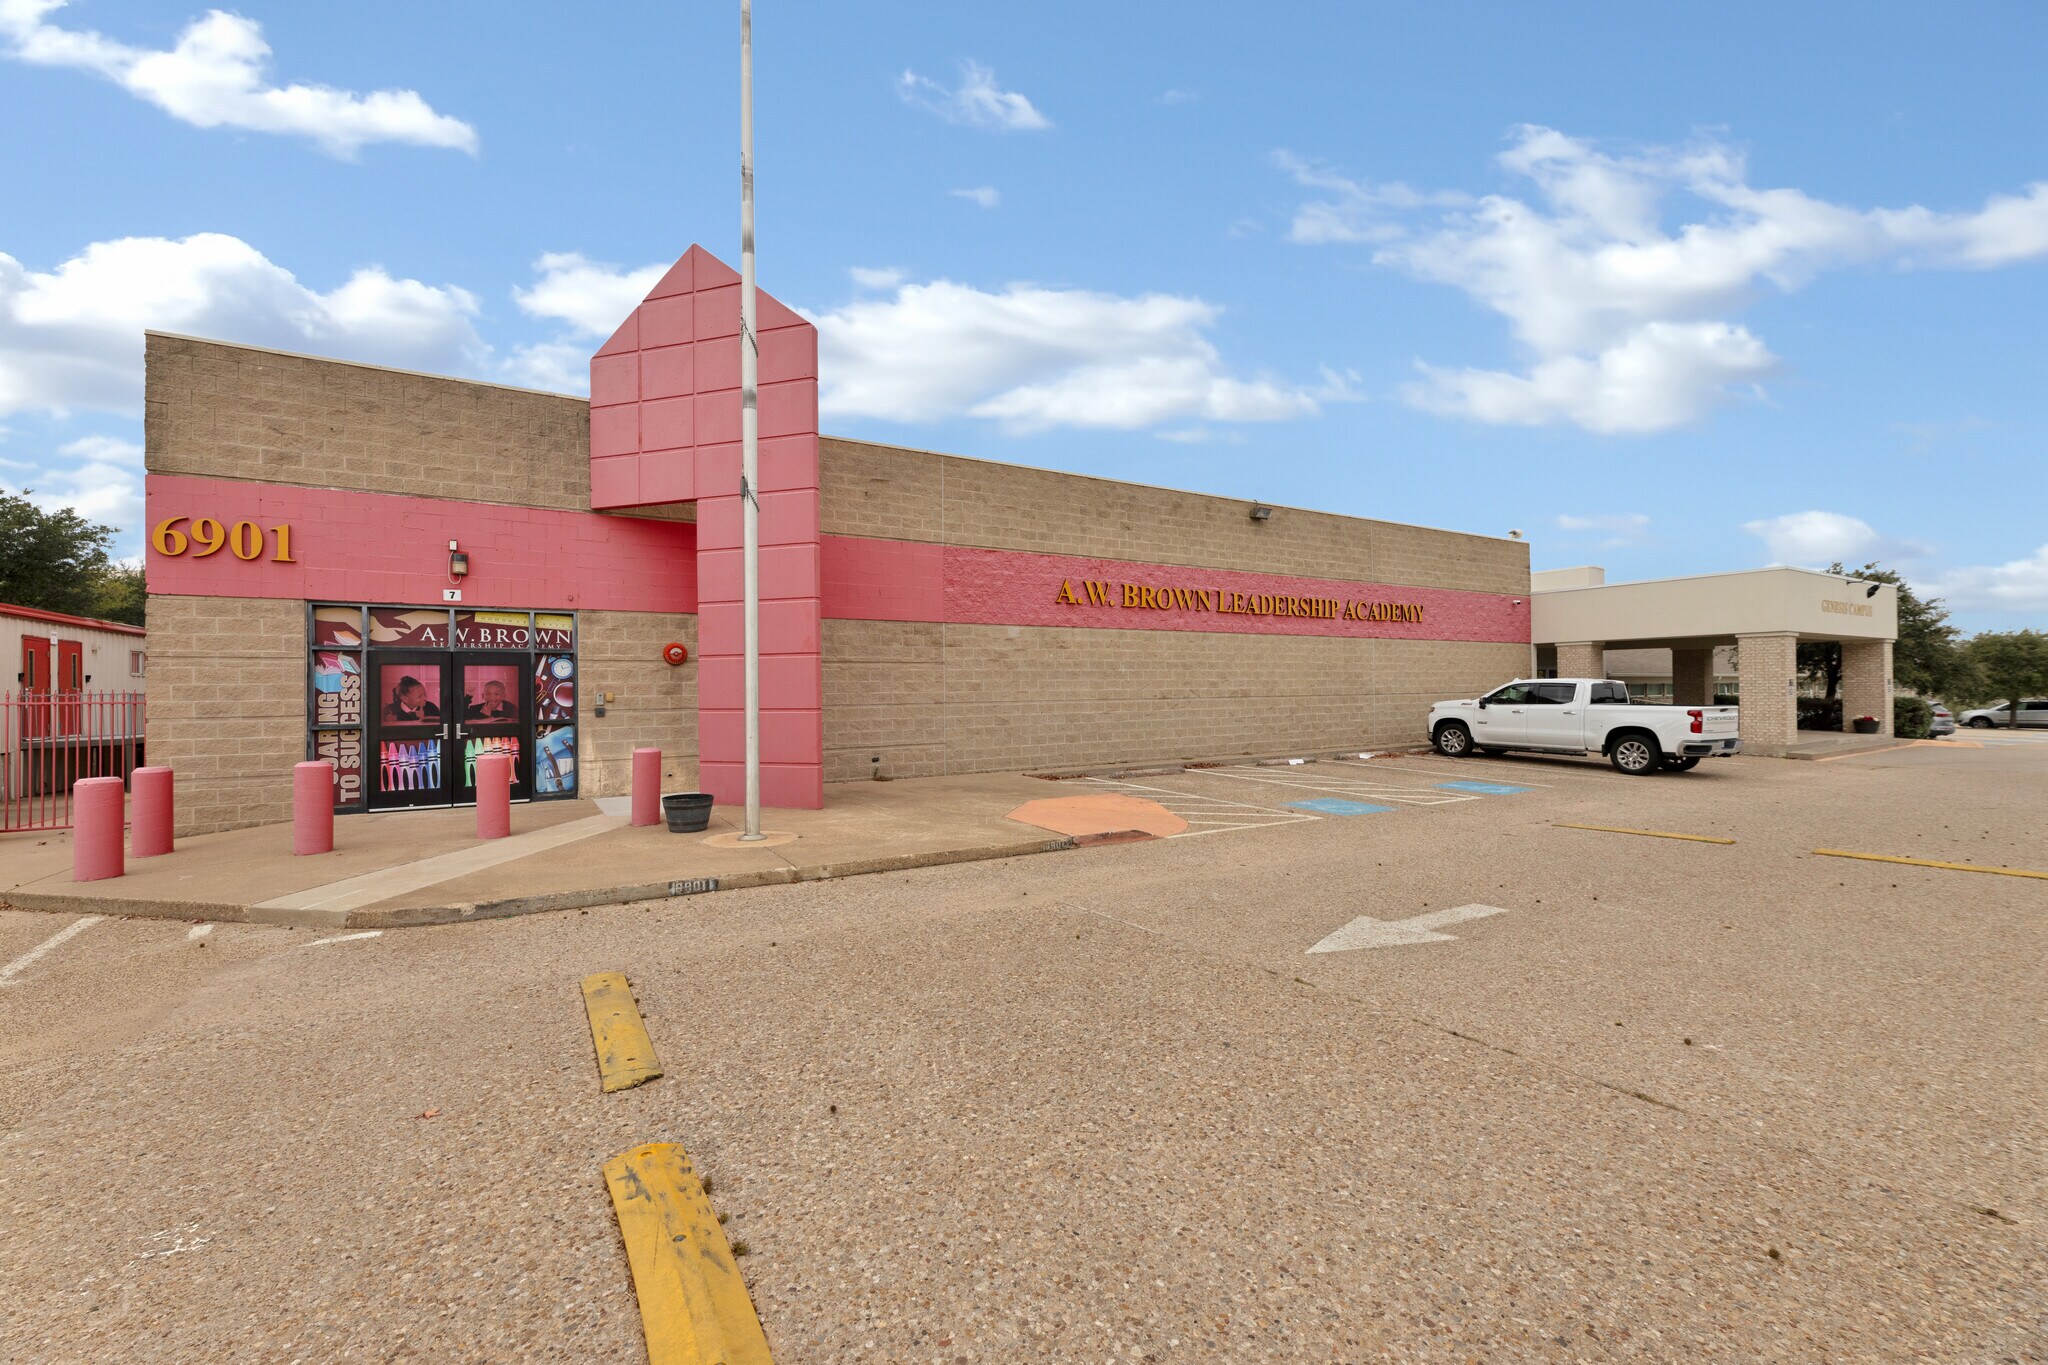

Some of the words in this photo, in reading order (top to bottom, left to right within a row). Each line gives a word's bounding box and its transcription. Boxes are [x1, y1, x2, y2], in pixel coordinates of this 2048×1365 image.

[152, 516, 296, 563] 6901
[449, 591, 456, 599] 7
[1056, 578, 1115, 607] A.W.
[1121, 583, 1211, 612] BROWN
[1216, 590, 1341, 620] LEADERSHIP
[1343, 600, 1424, 623] ACADEMY
[339, 674, 361, 769] SUCCESS
[340, 774, 361, 803] TO
